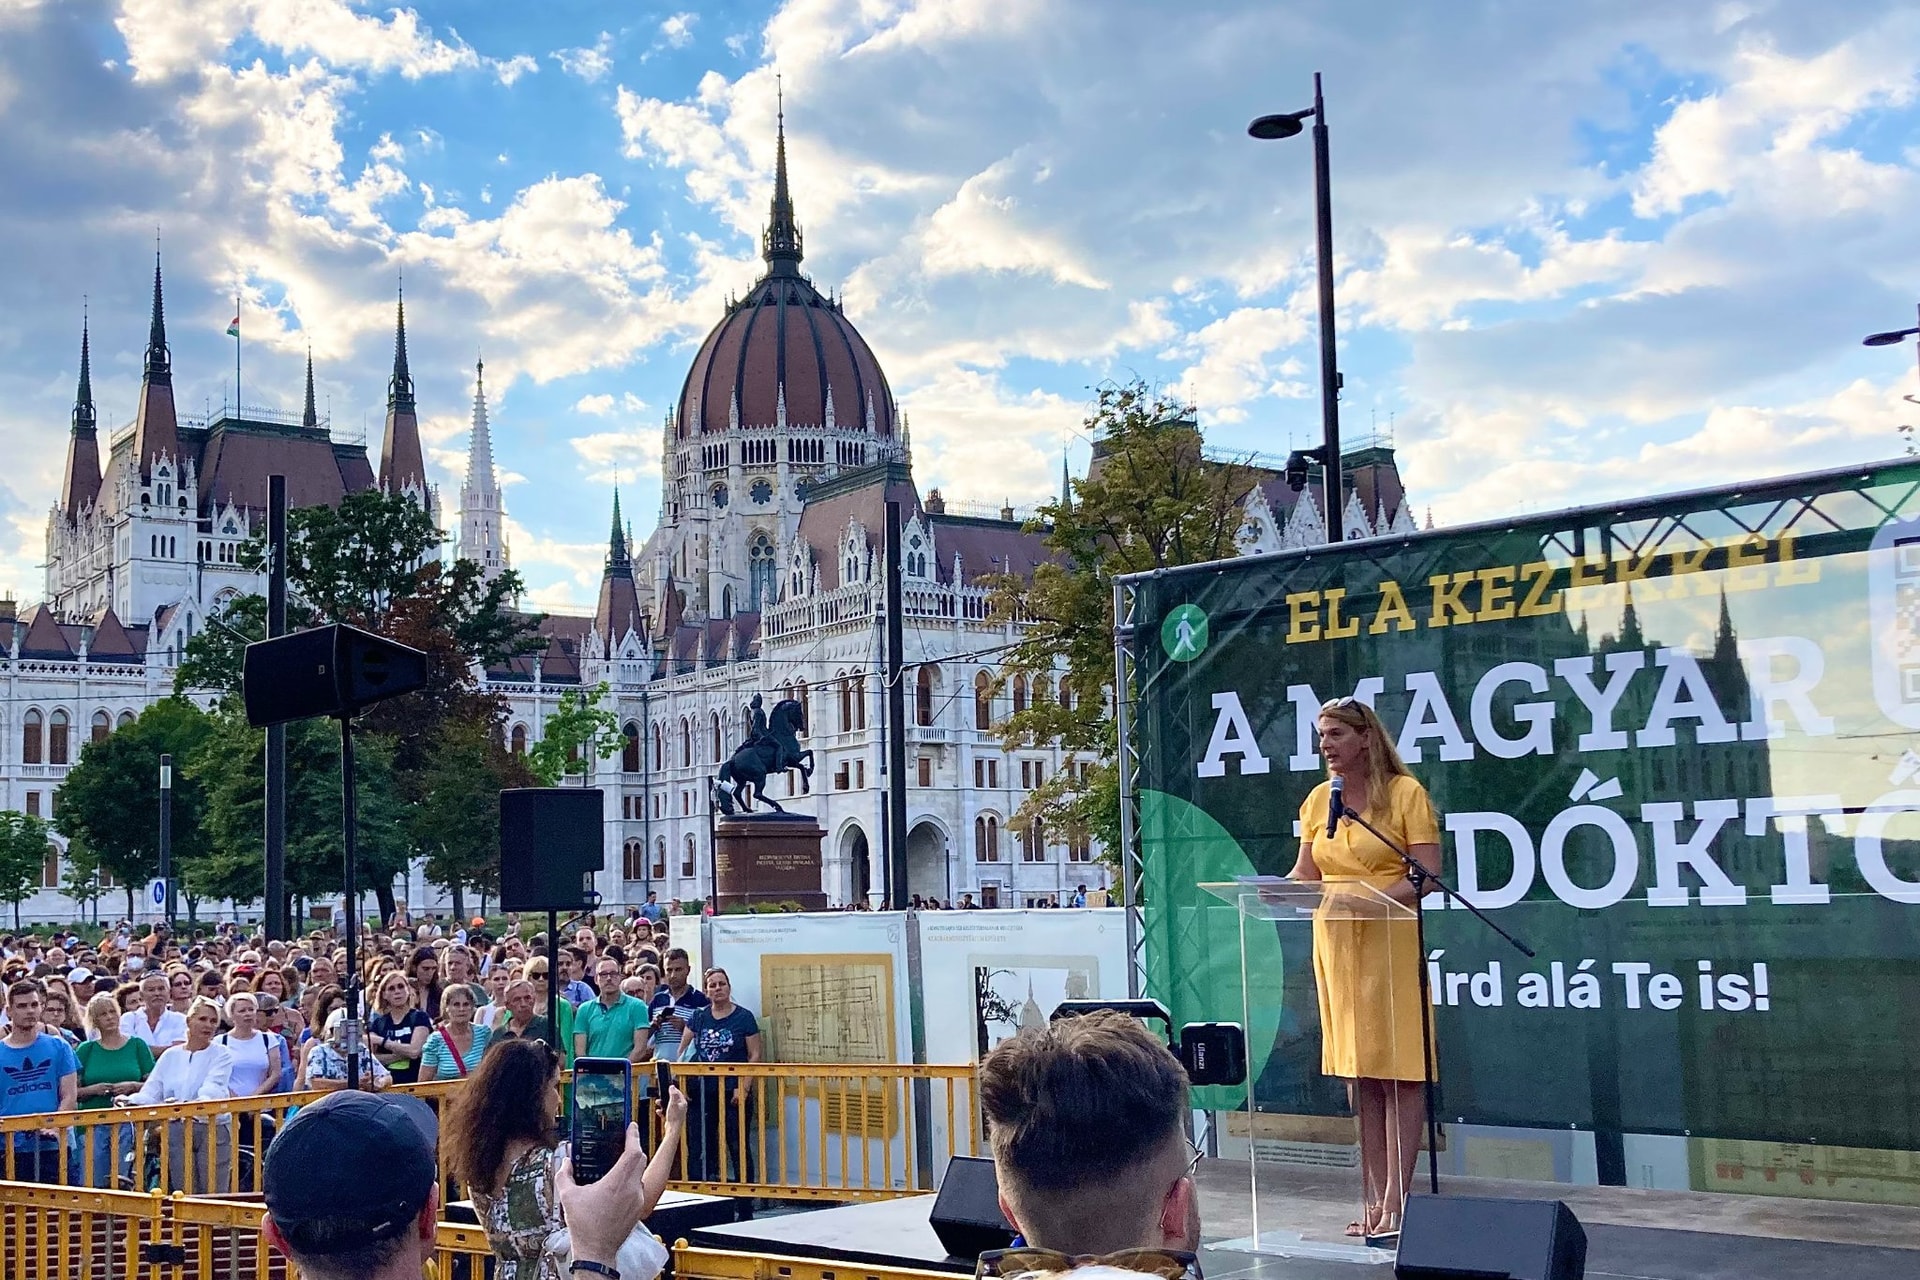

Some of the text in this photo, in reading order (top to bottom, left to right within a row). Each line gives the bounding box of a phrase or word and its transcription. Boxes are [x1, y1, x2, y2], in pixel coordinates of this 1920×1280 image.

[1285, 527, 1821, 644] EL A KEZEKKEL
[1197, 636, 1835, 778] A MAGYAR
[1517, 958, 1601, 1009] alá
[1612, 962, 1683, 1011] Te
[1697, 960, 1770, 1012] is!
[1197, 1042, 1206, 1070] Ulanzi
[7, 1081, 53, 1096] adidas
